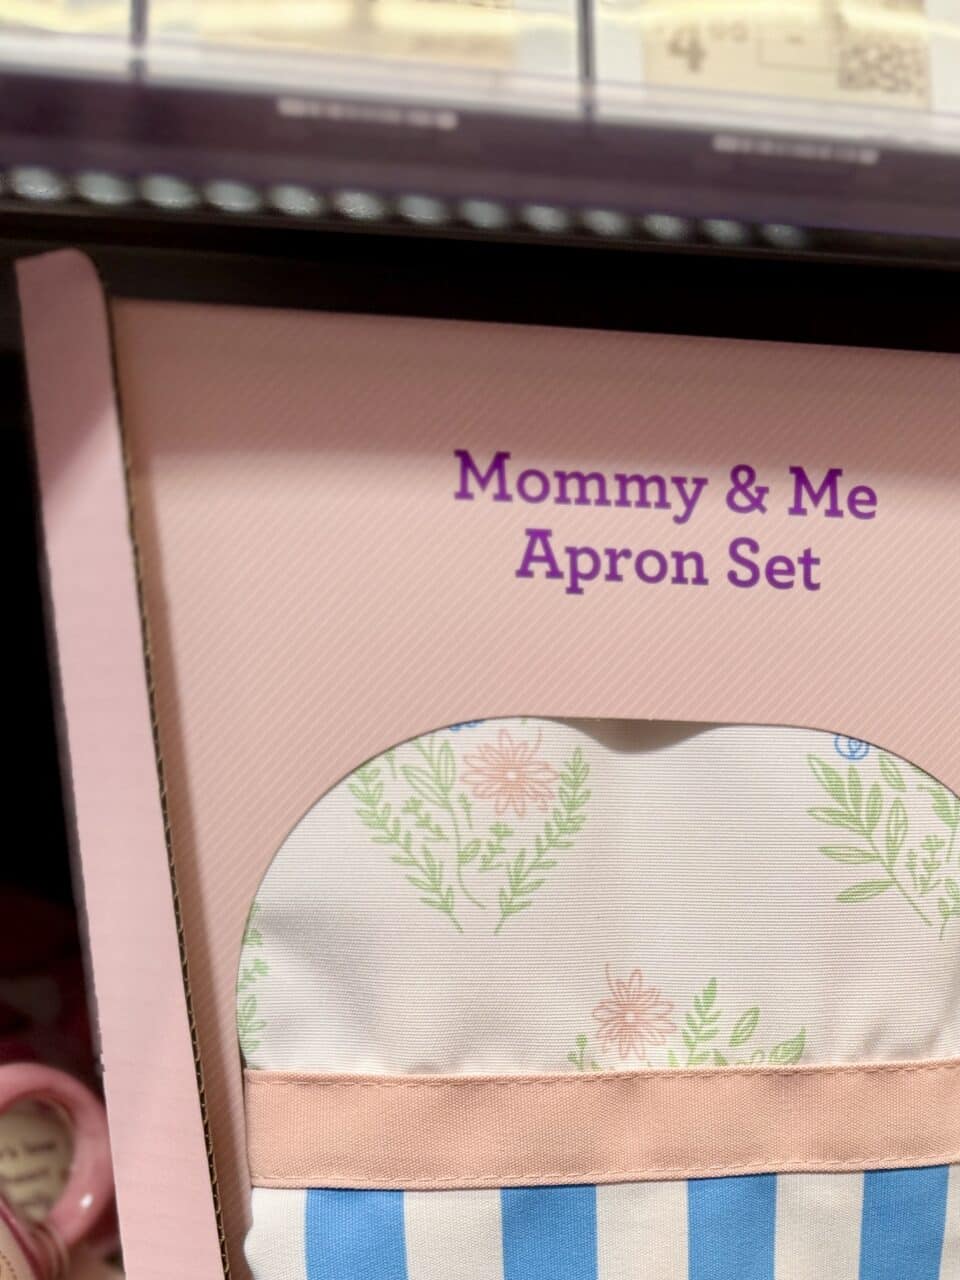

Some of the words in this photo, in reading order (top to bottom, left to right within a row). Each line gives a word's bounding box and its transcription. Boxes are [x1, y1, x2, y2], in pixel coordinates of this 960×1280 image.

[454, 448, 709, 524] Mommy
[726, 463, 770, 514] &
[788, 465, 878, 520] Me
[515, 528, 709, 595] Apron
[727, 537, 821, 591] Set
